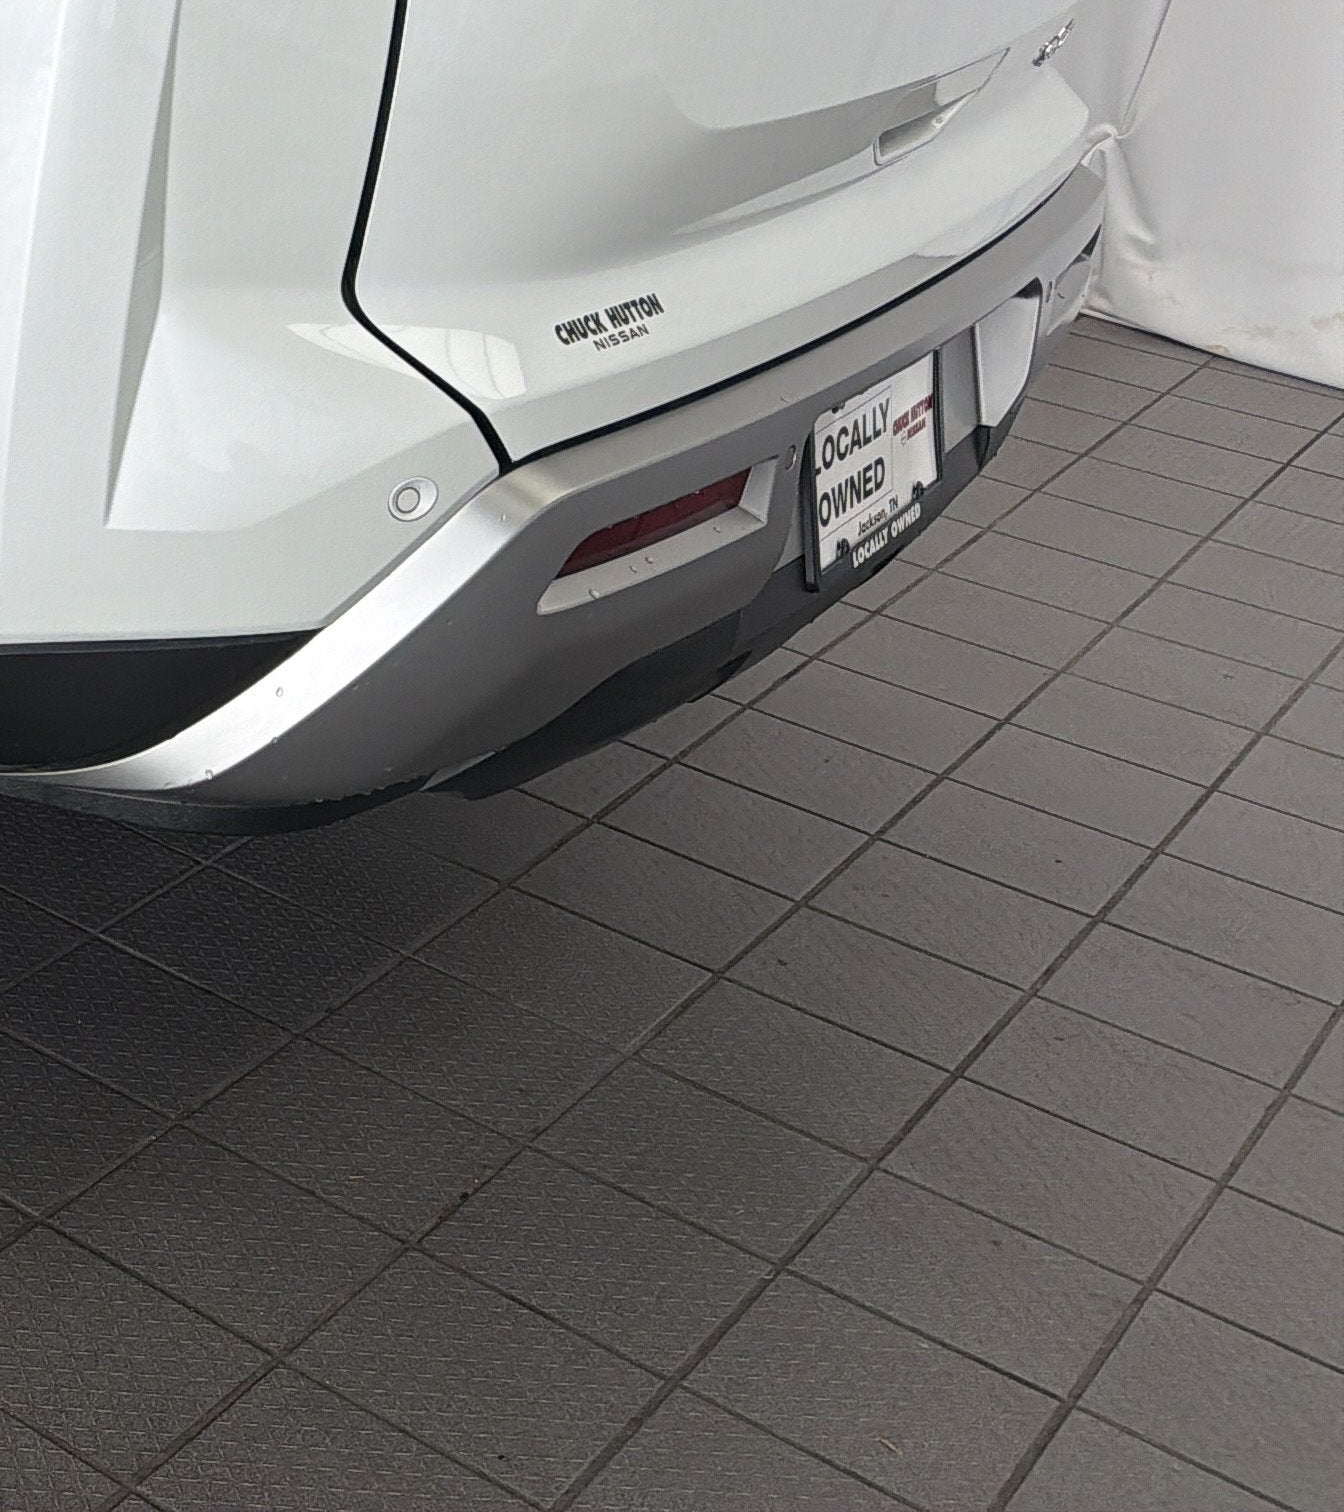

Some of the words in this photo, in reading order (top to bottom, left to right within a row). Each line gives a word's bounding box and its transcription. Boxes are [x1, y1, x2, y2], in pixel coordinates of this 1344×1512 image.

[554, 311, 609, 345] CHUCK
[603, 292, 665, 329] HUTTON
[592, 323, 650, 351] NISSAN
[818, 456, 886, 528] OWNED
[852, 526, 889, 569] LOCALLY
[890, 502, 921, 538] OWNED
